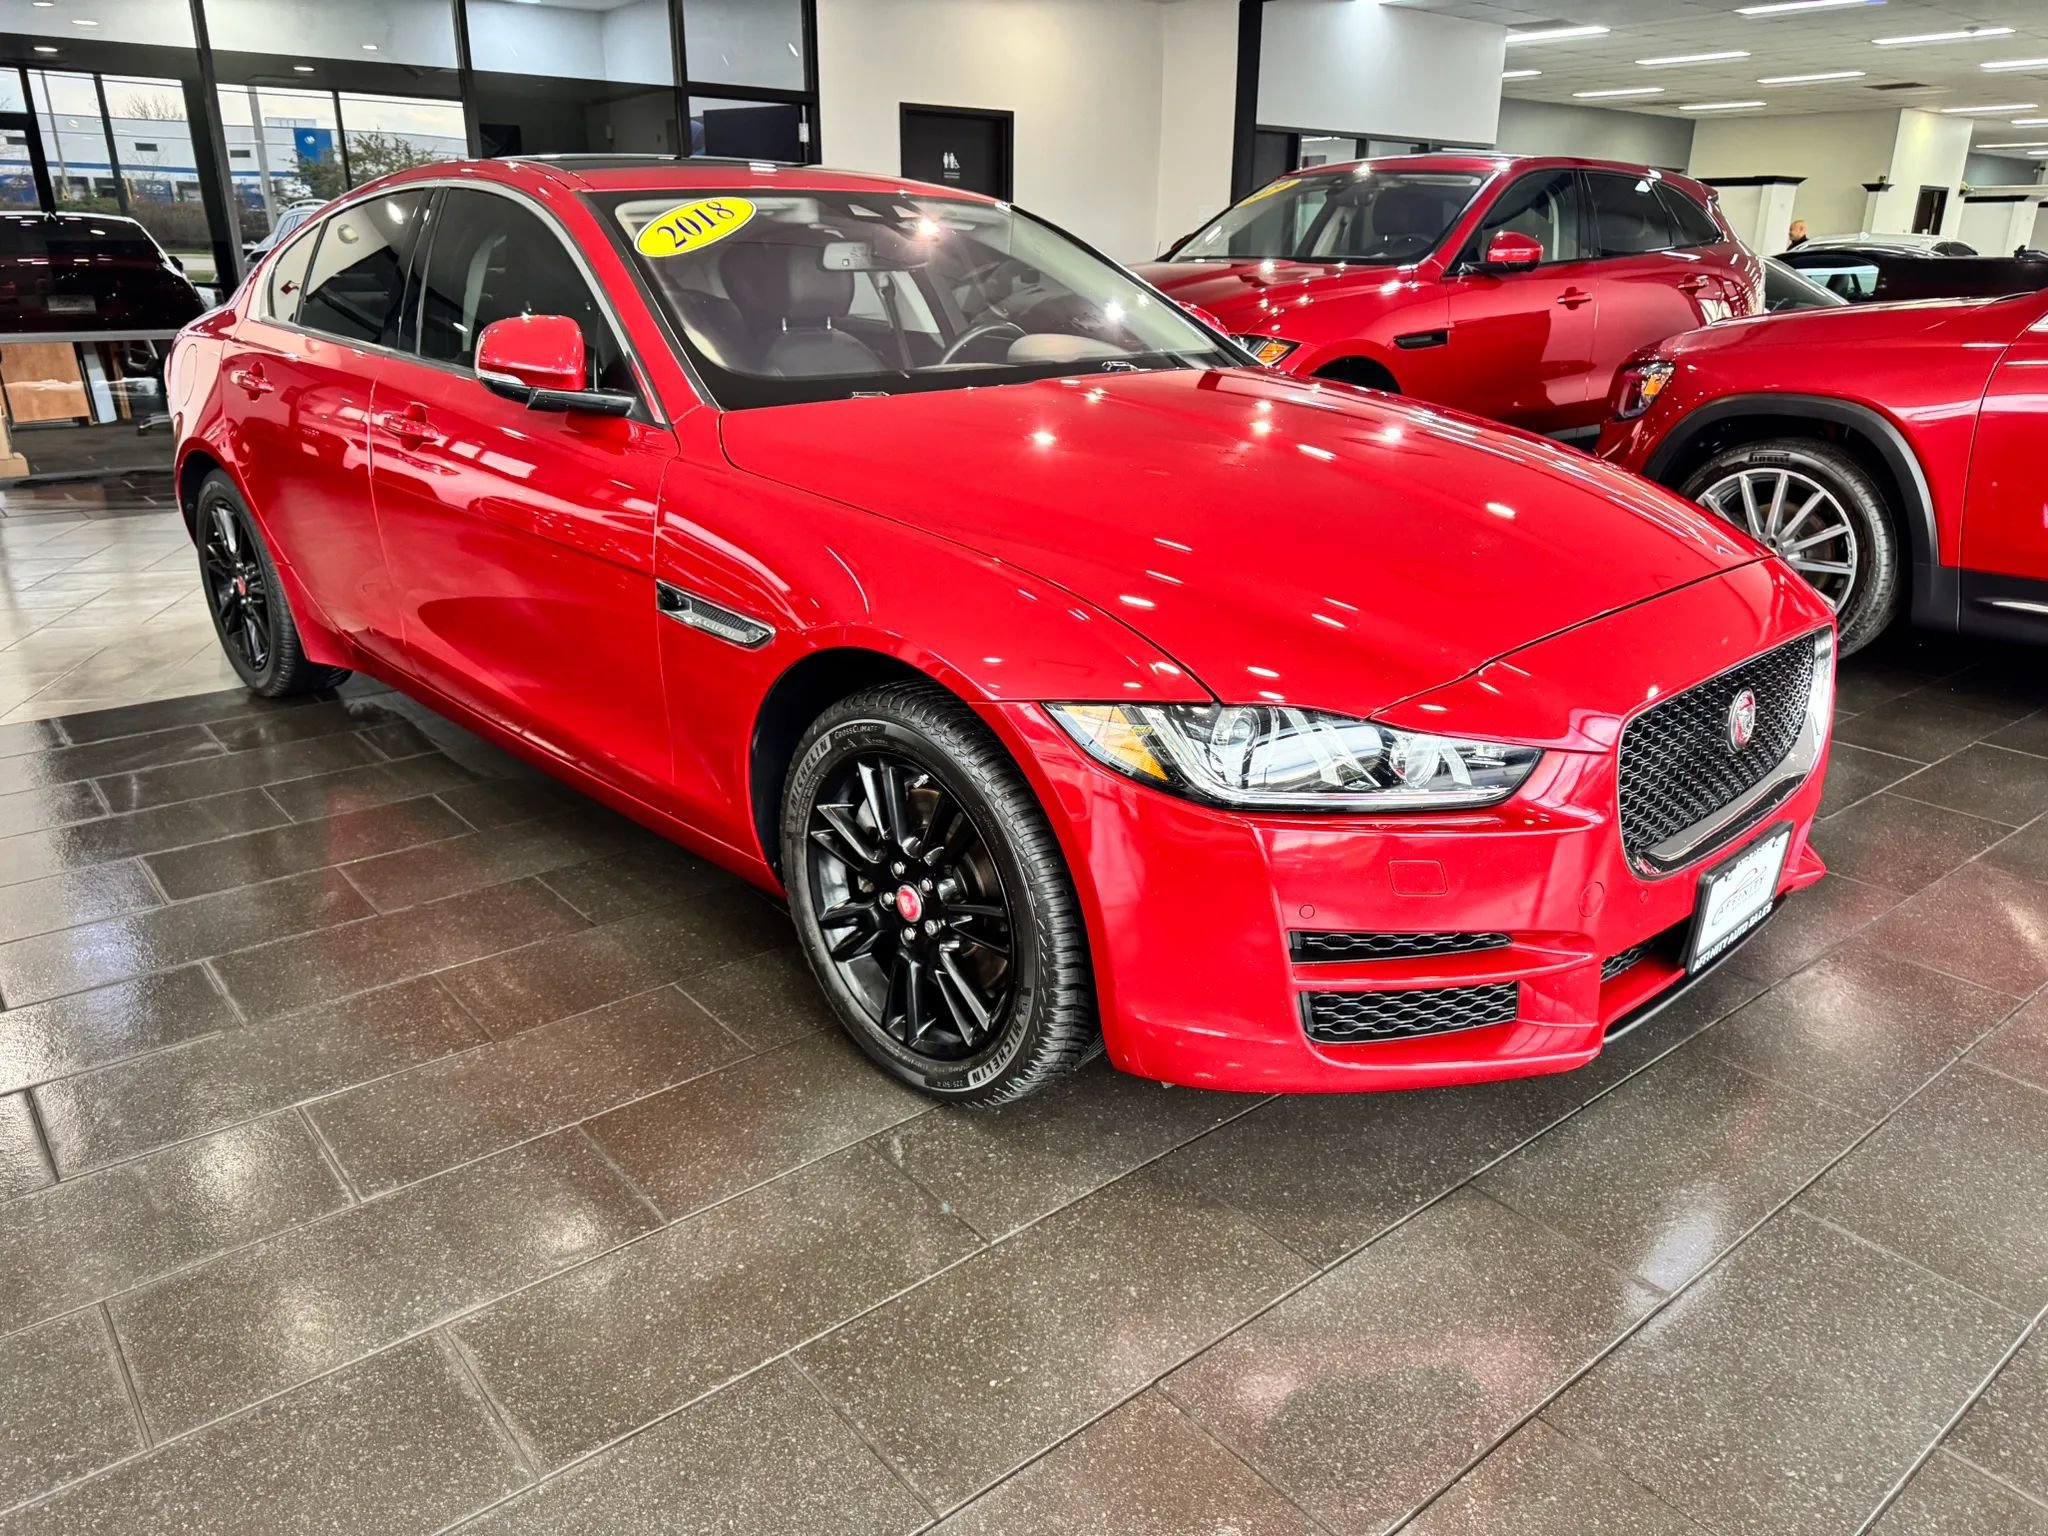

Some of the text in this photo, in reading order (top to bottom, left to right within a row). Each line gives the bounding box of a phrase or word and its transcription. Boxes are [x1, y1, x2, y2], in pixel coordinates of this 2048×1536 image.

[656, 201, 735, 248] 2018
[789, 739, 828, 809] MICHELIN
[1692, 901, 1774, 972] AFFINITY AUTO SALES
[971, 1019, 1023, 1084] MICHELIN
